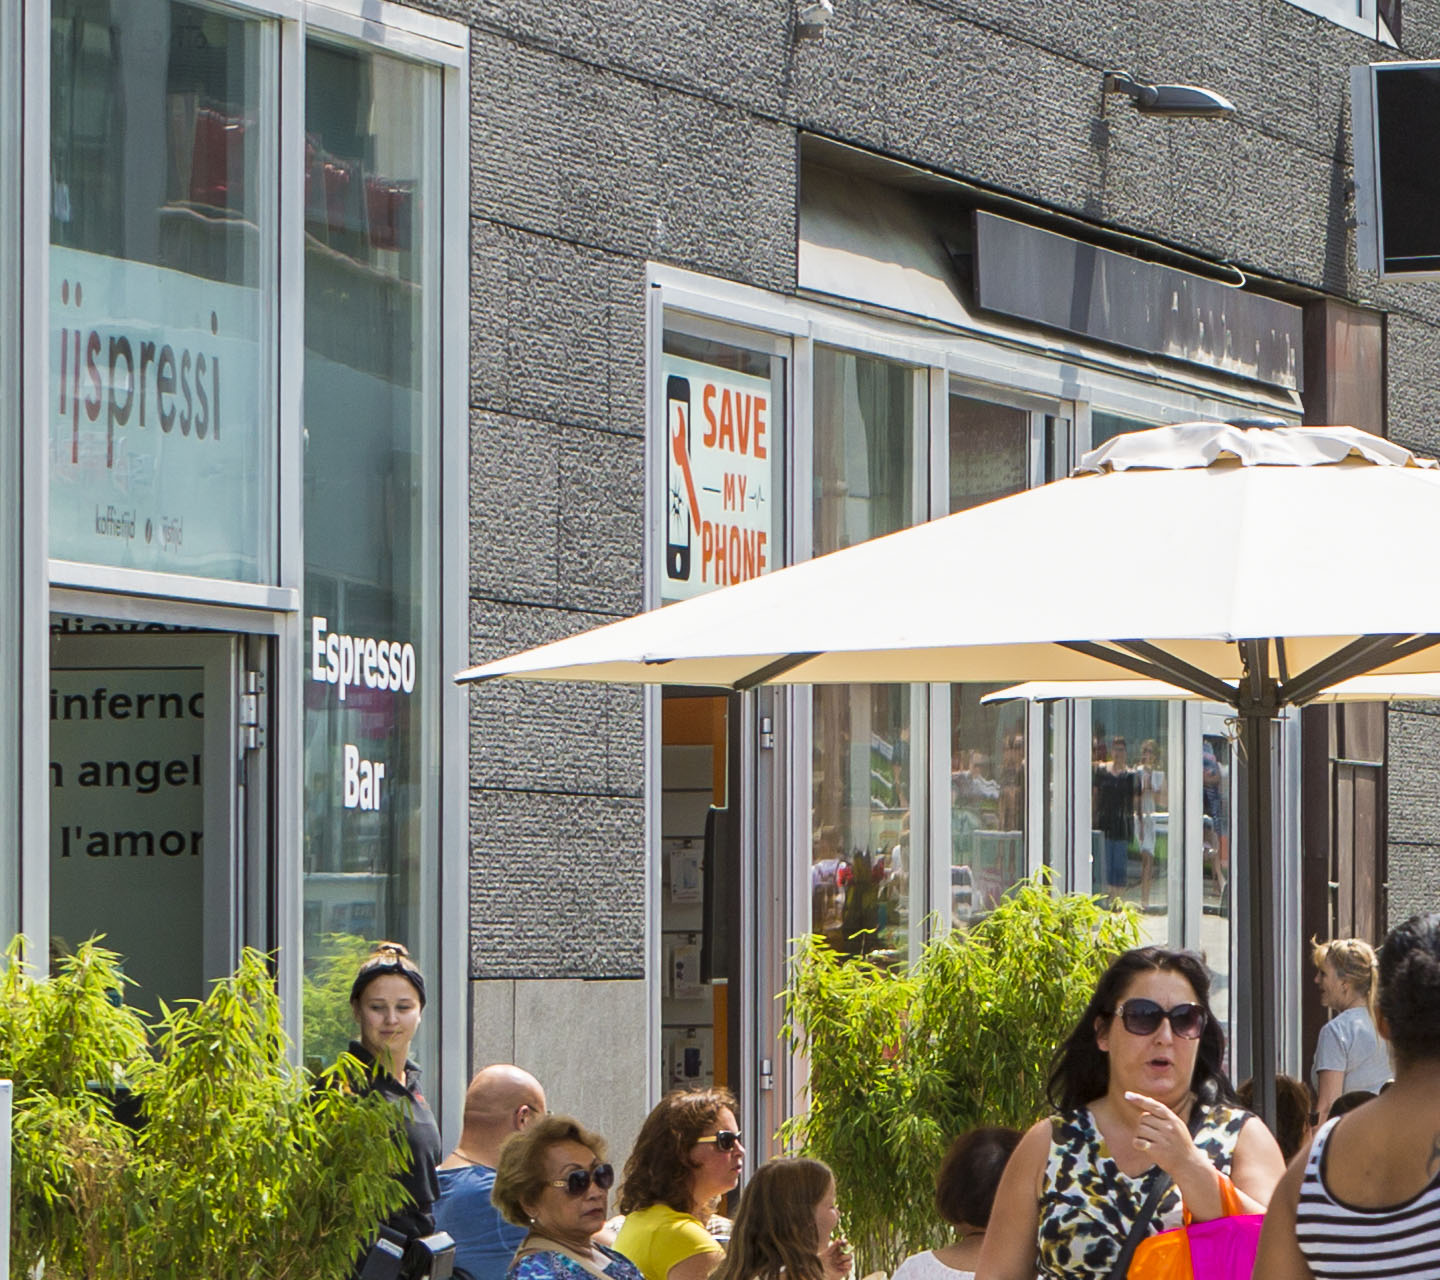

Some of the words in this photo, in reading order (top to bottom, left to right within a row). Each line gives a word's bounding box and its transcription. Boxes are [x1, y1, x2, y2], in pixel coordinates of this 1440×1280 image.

[60, 278, 221, 468] ijspressi
[703, 383, 768, 460] SAVE
[724, 473, 748, 513] MY
[702, 520, 768, 587] PHONE
[313, 616, 416, 701] Espresso
[345, 743, 385, 811] Bar
